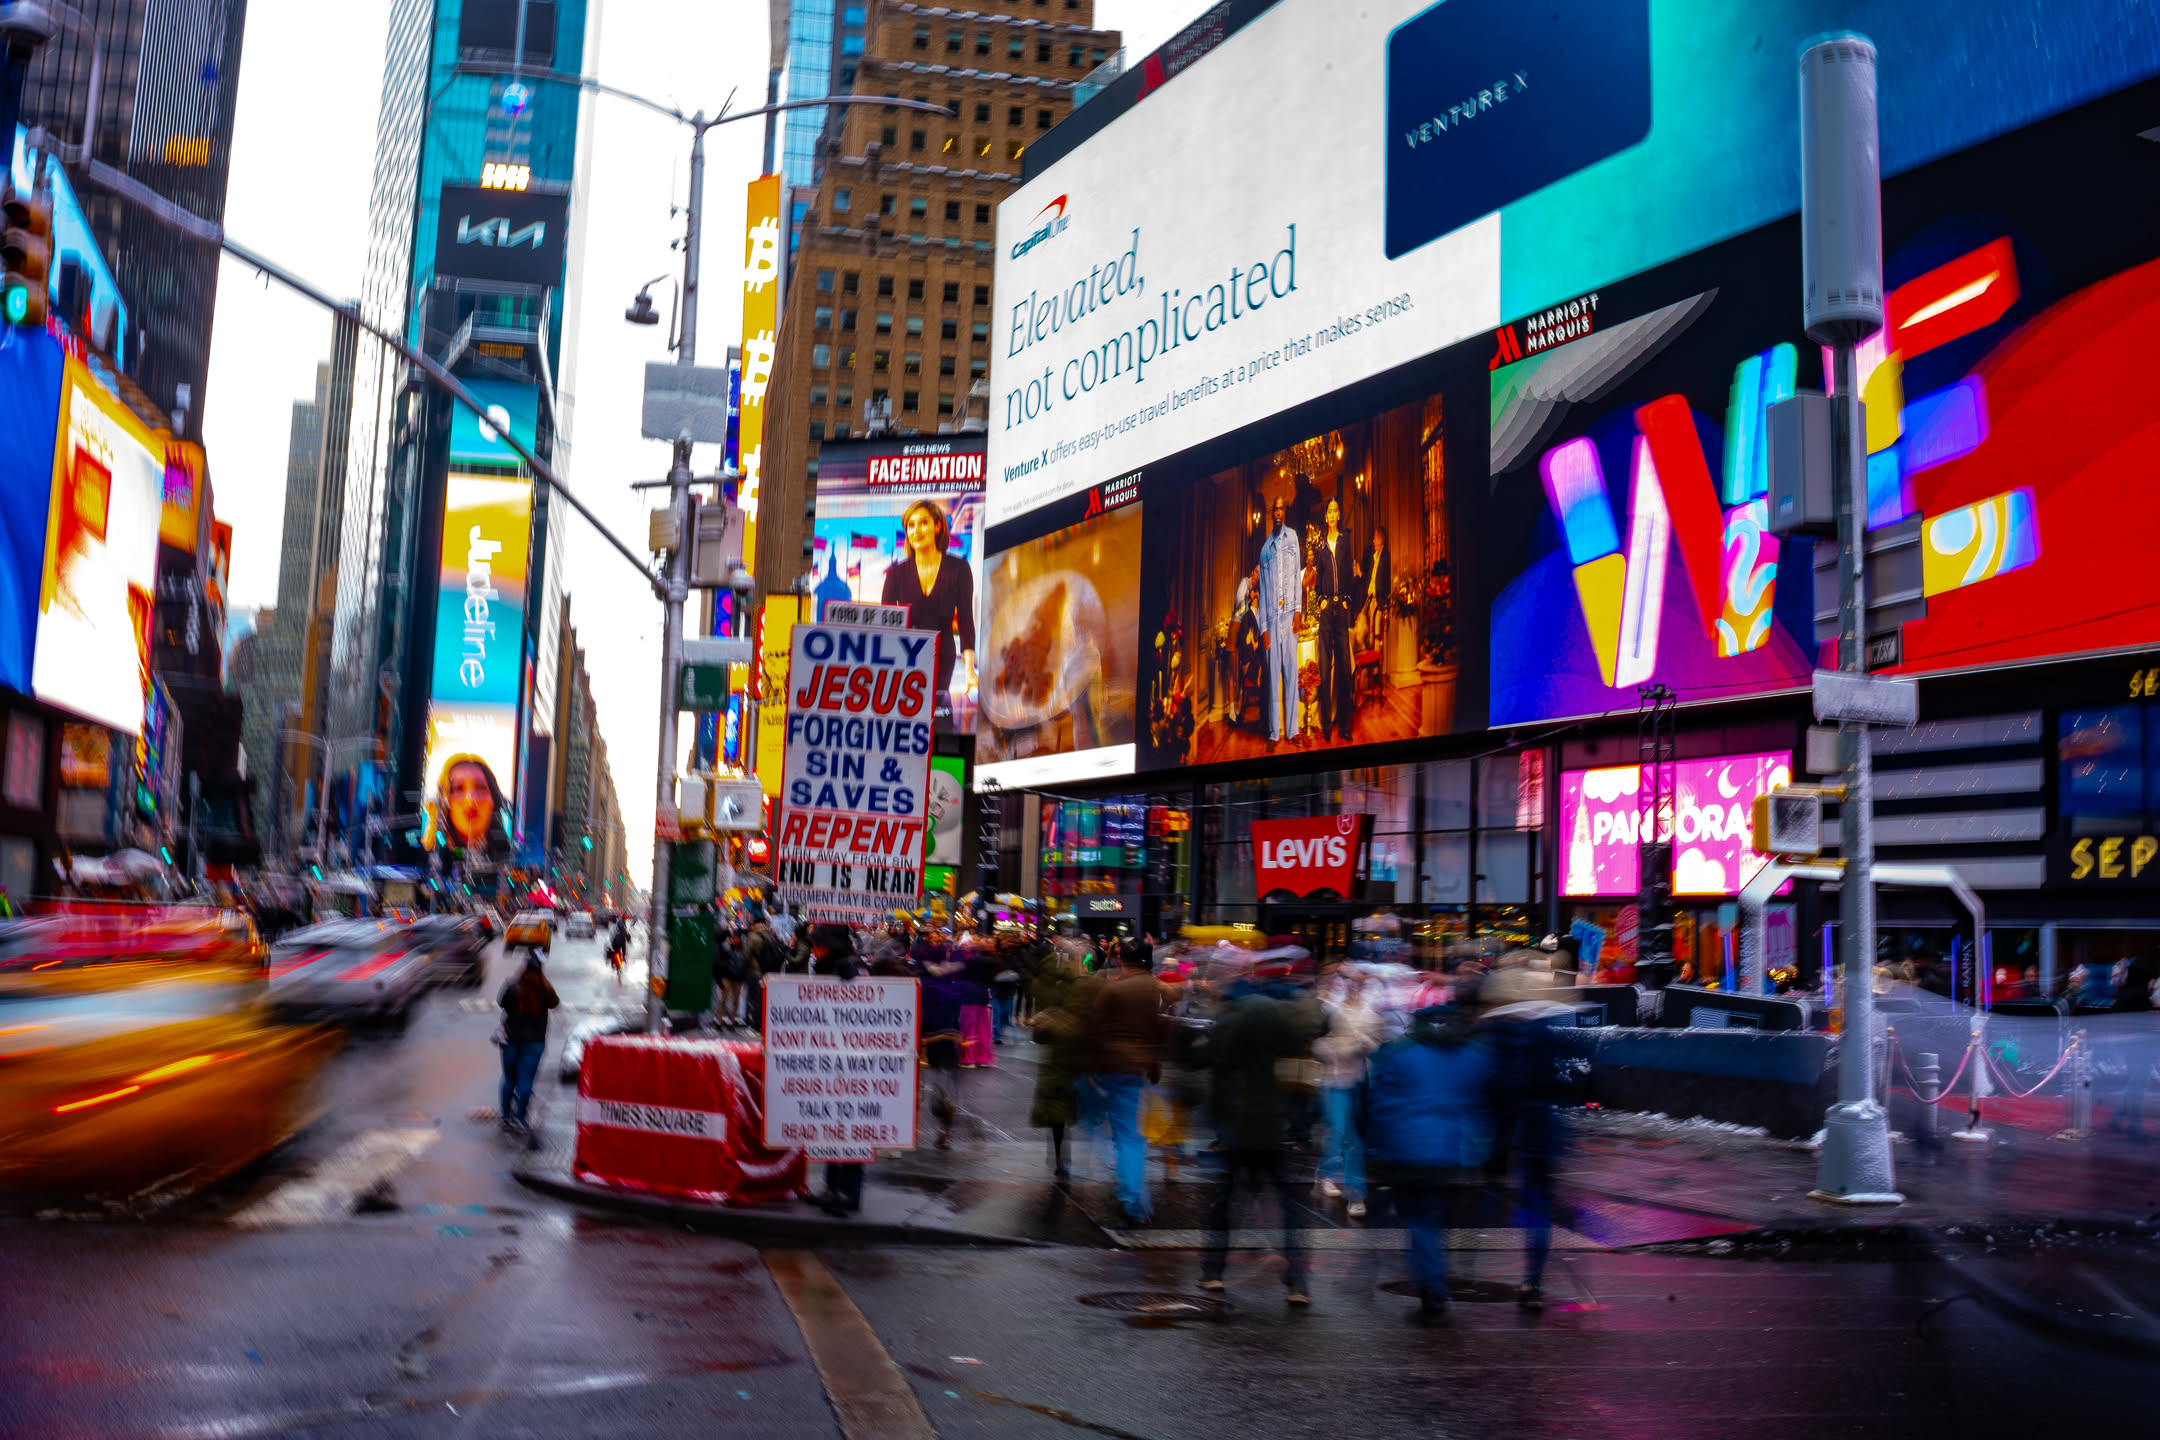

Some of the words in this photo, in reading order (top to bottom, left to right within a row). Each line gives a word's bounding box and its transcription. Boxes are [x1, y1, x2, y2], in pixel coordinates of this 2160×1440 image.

[1405, 80, 1508, 149] VENTURE
[1513, 68, 1528, 93] X
[1010, 221, 1051, 261] Capital
[1007, 227, 1145, 359] Elevated,
[1005, 366, 1054, 431] not
[1063, 223, 1298, 400] complicated
[1527, 293, 1599, 334] MARRIOTT
[1527, 315, 1590, 352] MARQUIS
[1004, 457, 1040, 483] Venture
[1041, 448, 1049, 468] X
[1050, 439, 1077, 464] offers
[1079, 413, 1137, 450] easy-to-use
[1139, 393, 1170, 425] travel
[1172, 376, 1219, 411] benefits
[1221, 369, 1235, 389] at
[1237, 366, 1246, 382] a
[1249, 350, 1281, 383] price
[1283, 333, 1312, 362] that
[1315, 314, 1362, 348] makes
[1365, 292, 1414, 327] sense.
[909, 444, 925, 456] CBS
[925, 443, 951, 454] NEWS
[869, 458, 911, 483] FACE
[915, 455, 981, 481] NATION
[1104, 471, 1143, 495] MARRIOTT
[890, 482, 937, 494] MARGARET
[939, 481, 980, 492] BRENNAN
[1104, 487, 1137, 508] MARQUIS
[803, 629, 930, 667] ONLY
[797, 664, 927, 718] JESUS
[787, 713, 931, 755] FORGIVES
[806, 751, 866, 781] SIN
[880, 757, 903, 783] &
[790, 779, 915, 815] SAVES
[782, 811, 922, 856] REPENT
[1593, 801, 1746, 845] PANDORA
[782, 848, 811, 861] TURN
[816, 850, 848, 863] AWAY
[852, 854, 887, 867] FROM
[892, 857, 913, 869] SIN
[779, 860, 815, 886] END
[831, 864, 851, 889] IS
[866, 866, 916, 894] NEAR
[780, 887, 836, 905] JUDGMENT
[837, 892, 859, 907] DAY
[861, 894, 871, 907] IS
[873, 896, 916, 911] COMING
[808, 909, 866, 921] MATTHEW
[770, 1006, 829, 1026] SUICIDAL
[771, 1029, 806, 1048] DONT
[810, 1030, 837, 1049] KILL
[841, 1031, 911, 1050] YOURSELF
[774, 1054, 816, 1073] THERE
[819, 1055, 832, 1073] IS
[834, 1055, 843, 1073] A
[847, 1056, 875, 1074] WAY
[879, 1056, 906, 1074] OUT
[781, 1077, 822, 1096] JESUS
[825, 1077, 869, 1097] LOVES
[871, 1078, 899, 1097] YOU
[599, 1101, 643, 1127] TIMES
[644, 1104, 708, 1136] SQUARE
[798, 1100, 834, 1120] TALK
[836, 1100, 854, 1119] TO
[857, 1102, 883, 1120] HIM
[781, 1122, 818, 1142] READ
[820, 1122, 848, 1142] THE
